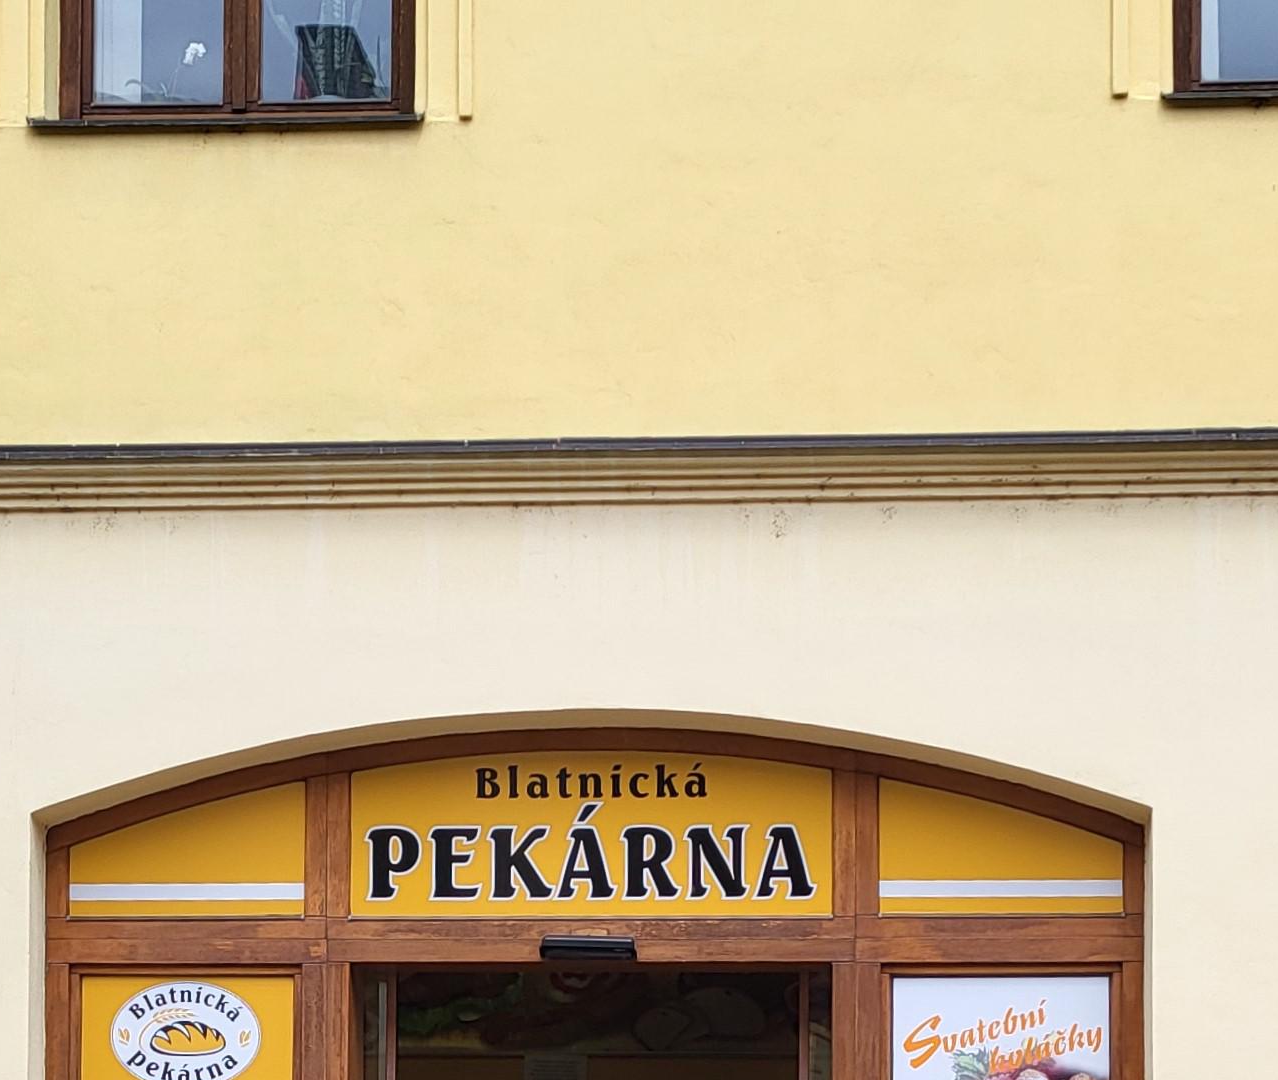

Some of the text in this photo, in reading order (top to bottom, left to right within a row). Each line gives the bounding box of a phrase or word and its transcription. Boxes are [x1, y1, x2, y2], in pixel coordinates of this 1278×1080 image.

[475, 763, 708, 799] Blatnická
[365, 801, 817, 901] PEKÁRNA
[128, 986, 244, 1023] Blatnická
[902, 999, 1048, 1070] Svatební
